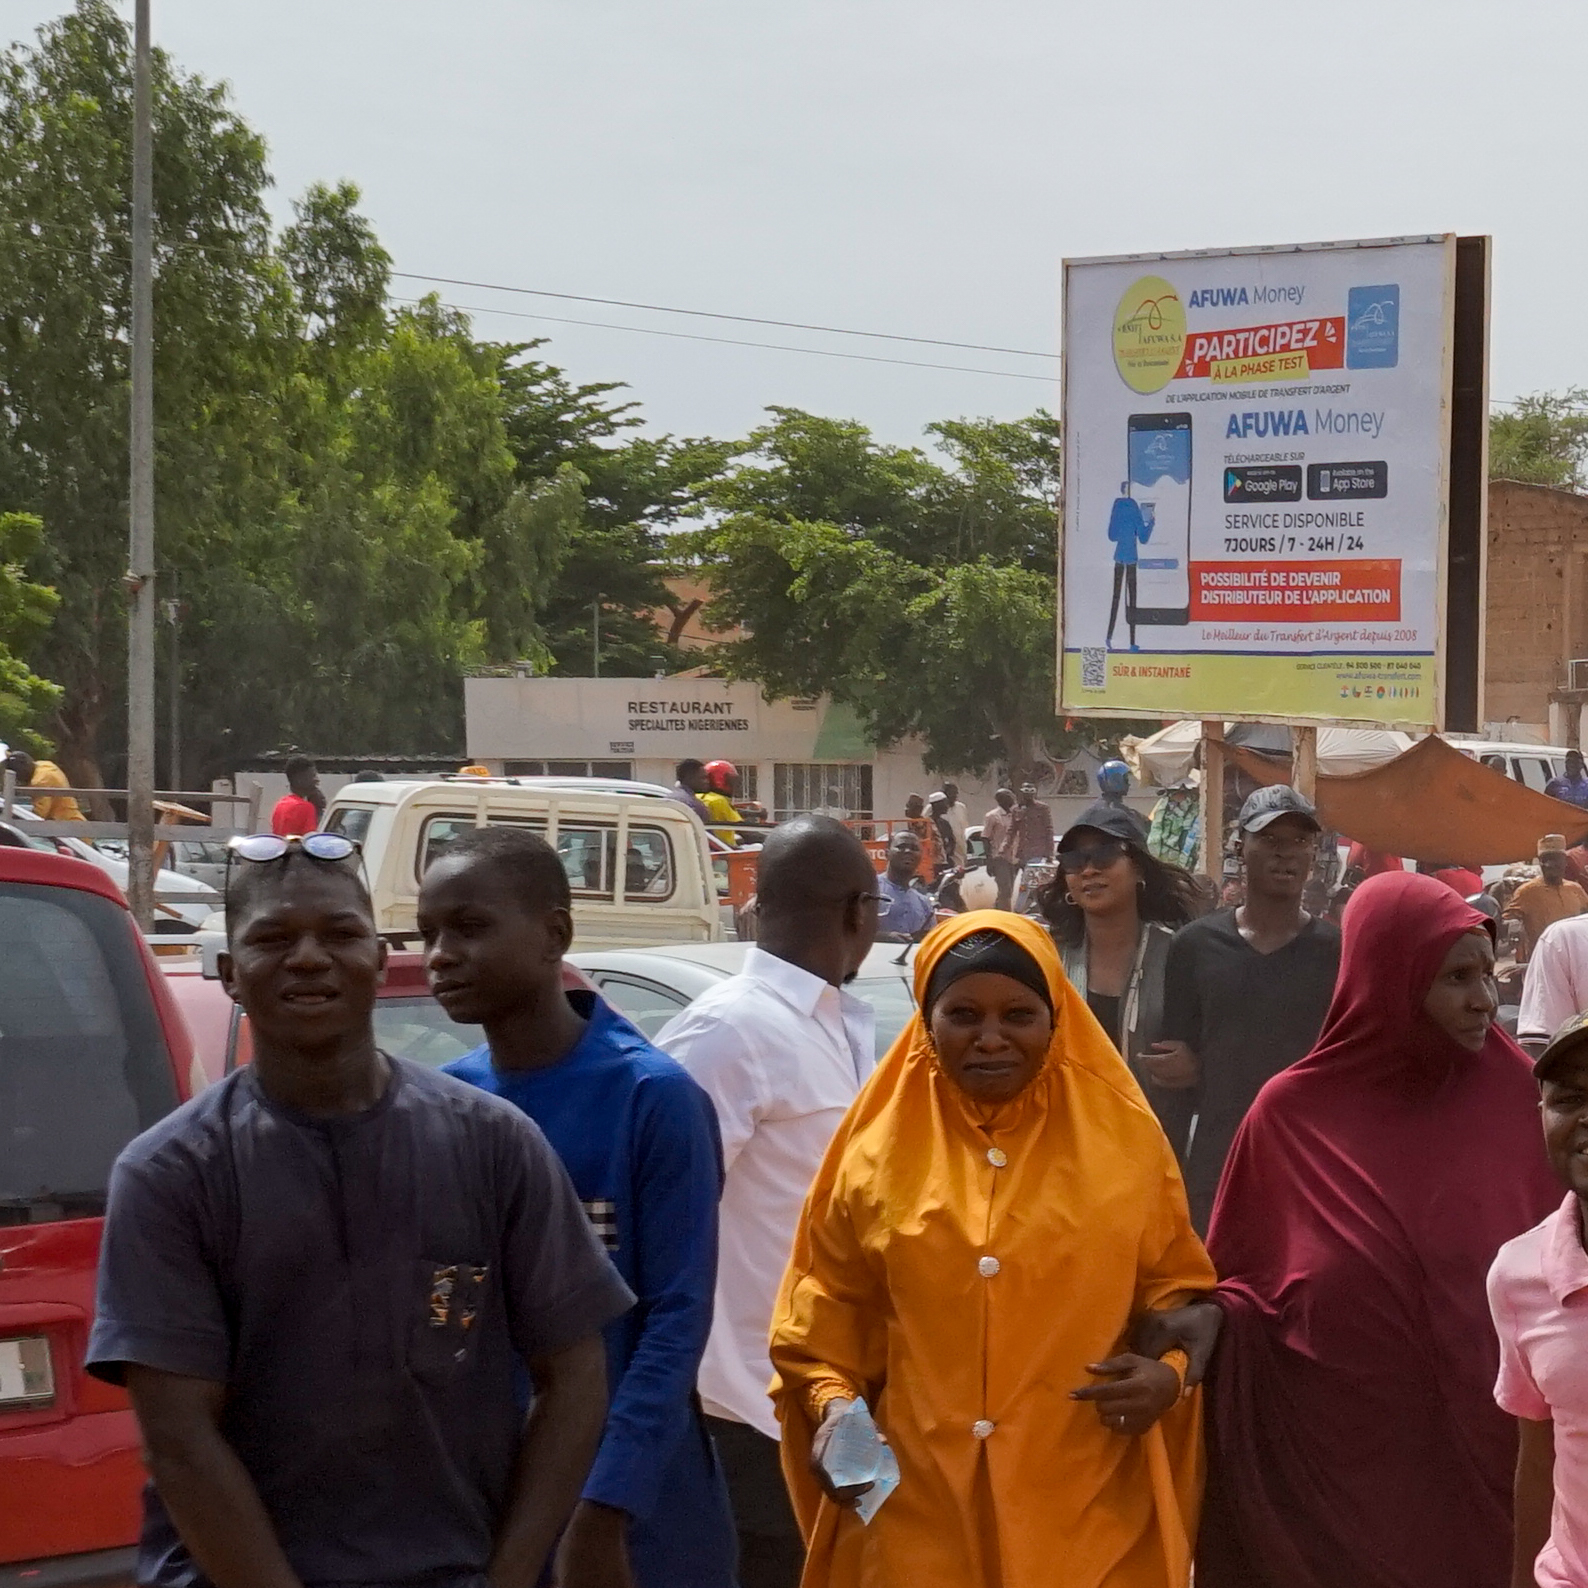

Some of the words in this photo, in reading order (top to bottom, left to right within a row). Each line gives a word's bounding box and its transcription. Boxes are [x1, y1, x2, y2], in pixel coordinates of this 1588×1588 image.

[1189, 287, 1249, 308] AFUWA
[1253, 285, 1306, 306] Money
[1193, 321, 1320, 363] PARTICIPEZ
[1213, 363, 1222, 380] À
[1224, 365, 1238, 379] LA
[1240, 360, 1277, 377] PHASE
[1278, 356, 1304, 372] TEST
[1229, 389, 1257, 400] MOBILE
[1257, 389, 1268, 399] DE
[1270, 386, 1313, 398] TRANSFERT
[1225, 410, 1309, 438] AFUWA
[1315, 408, 1385, 438] Money
[1290, 452, 1305, 462] SUR
[1245, 480, 1277, 495] Google
[1279, 479, 1298, 494] Play
[1333, 478, 1350, 493] App
[1352, 477, 1375, 489] Store
[1225, 513, 1279, 529] SERVICE
[1283, 512, 1365, 528] DISPONIBLE
[1224, 538, 1276, 553] 7JOURS
[1287, 538, 1296, 552] 7
[1307, 537, 1335, 552] 24H
[1346, 536, 1364, 551] 24
[1200, 570, 1268, 587] POSSIBILITÉ
[1270, 572, 1287, 586] DE
[1289, 571, 1341, 586] DEVENIR
[1200, 590, 1282, 605] DISTRIBUTEUR
[1284, 590, 1300, 605] DE
[1303, 589, 1391, 605] L'APPLICATION
[1213, 628, 1250, 641] Meilleur
[1253, 628, 1268, 641] du
[1270, 629, 1314, 643] Transfert
[1314, 628, 1358, 645] d'Argent
[1359, 628, 1392, 645] depuis
[1393, 629, 1418, 642] 2008
[1130, 666, 1136, 677] &
[1138, 664, 1191, 678] INSTANTANÉ
[628, 702, 734, 715] RESTAURANT
[628, 719, 686, 731] SPECIALITES
[688, 719, 749, 731] NIGERIENNES
